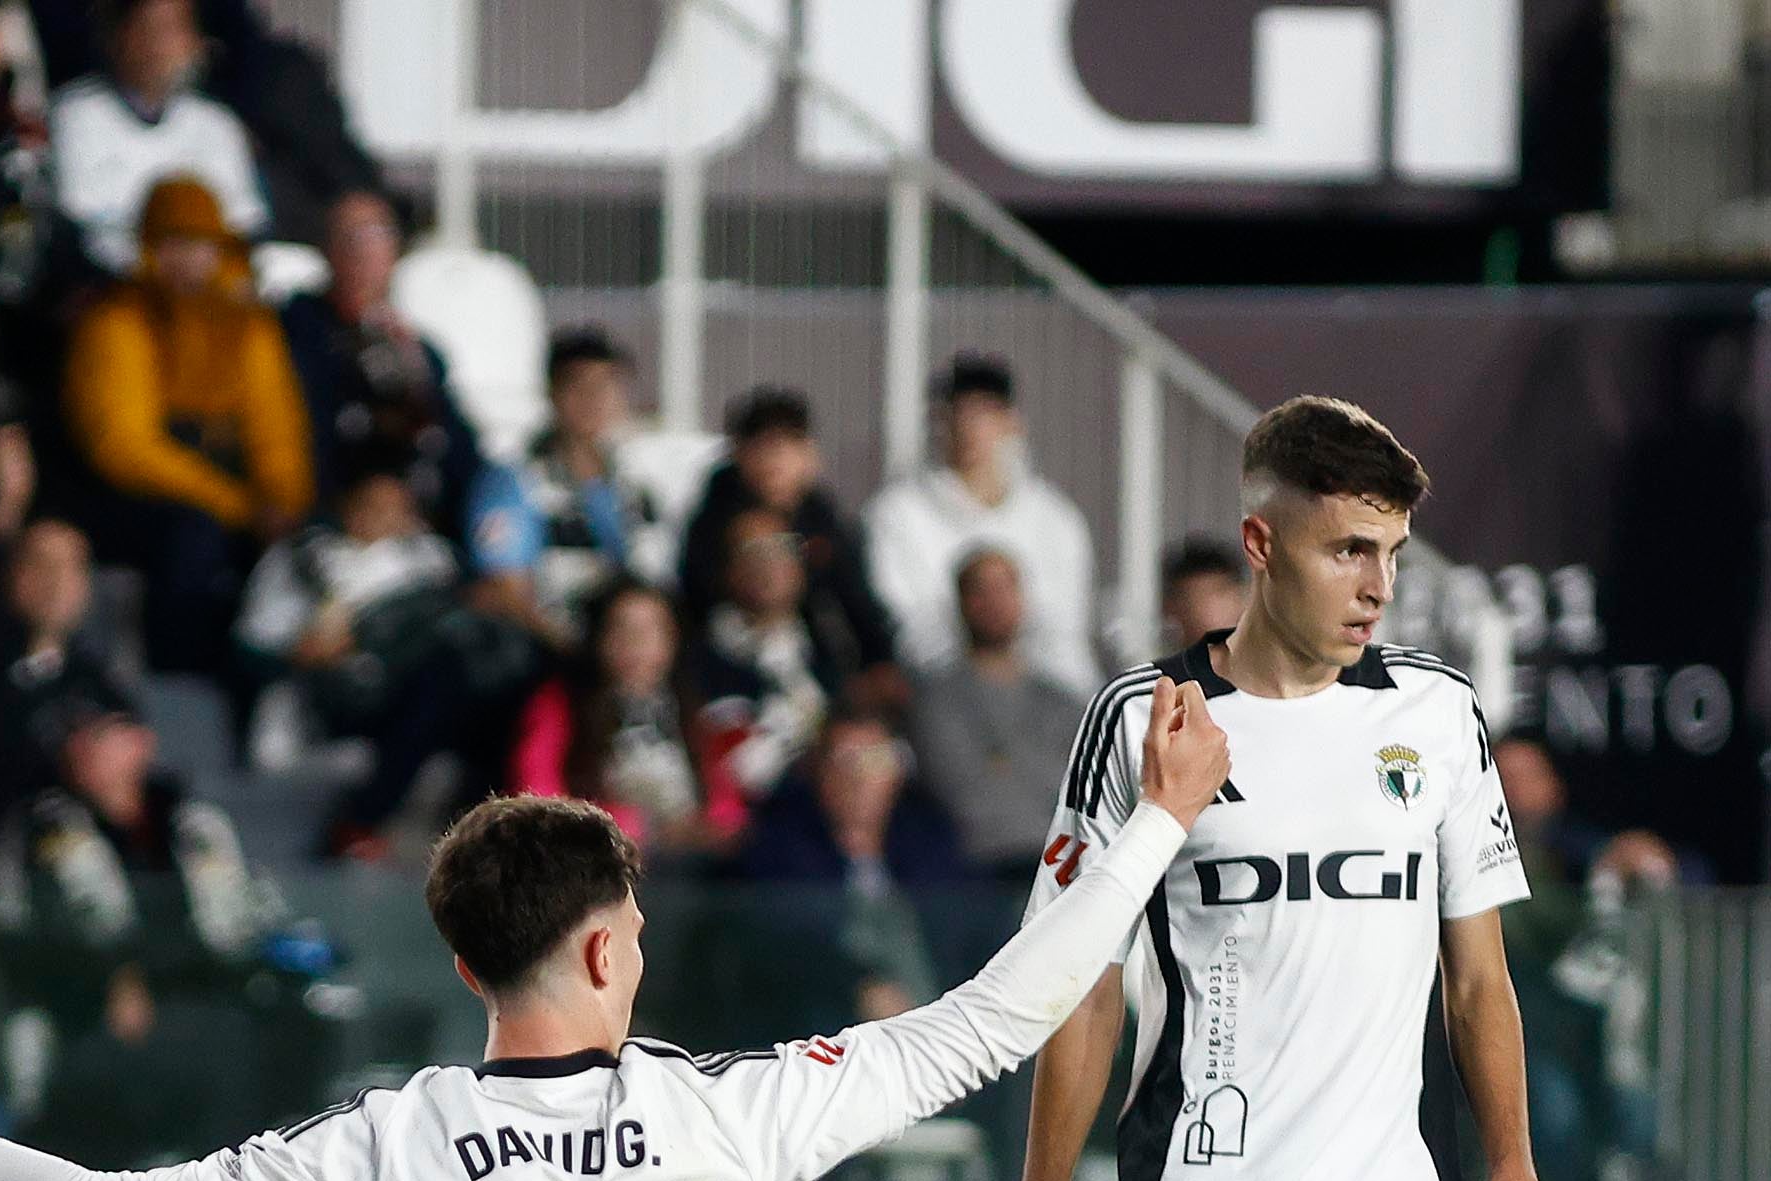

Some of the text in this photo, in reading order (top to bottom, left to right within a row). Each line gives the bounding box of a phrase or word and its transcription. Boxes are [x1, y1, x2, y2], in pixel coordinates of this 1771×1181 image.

[338, 0, 1521, 183] DIGI
[1193, 849, 1423, 906] DIGI
[1205, 962, 1223, 1081] Burgos 2031
[1222, 935, 1239, 1081] RENACIMIENTO
